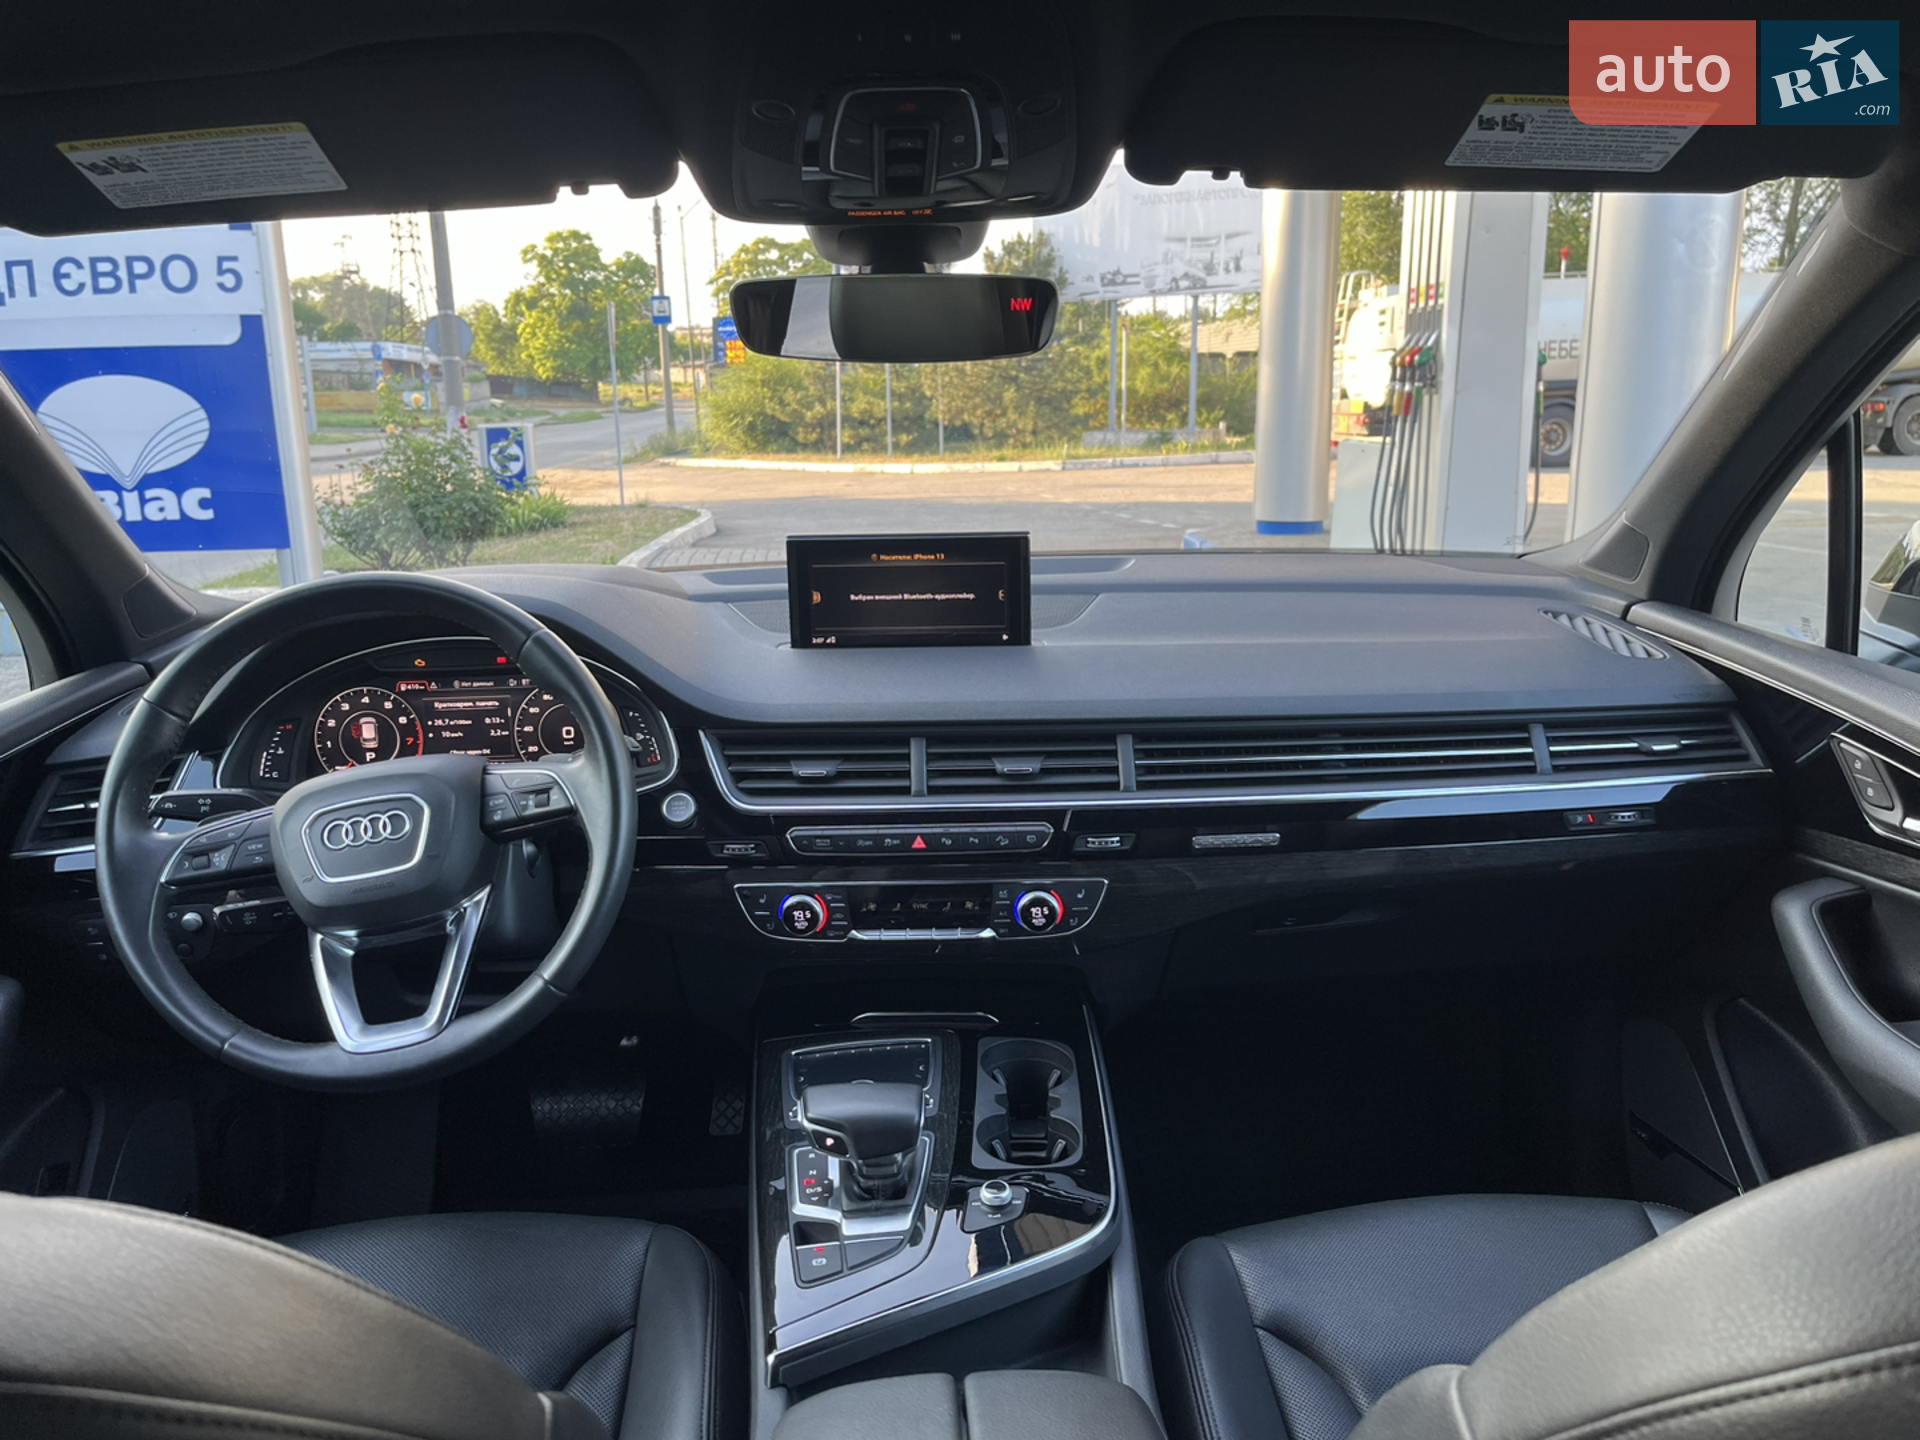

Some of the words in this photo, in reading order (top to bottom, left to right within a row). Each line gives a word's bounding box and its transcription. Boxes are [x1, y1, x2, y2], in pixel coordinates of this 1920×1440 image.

[0, 259, 37, 306] П
[52, 253, 199, 298] ЄВРО
[215, 255, 243, 294] 5
[1010, 297, 1033, 311] NW
[360, 695, 370, 704] 4
[340, 702, 350, 711] 3
[383, 701, 394, 709] 5
[327, 719, 337, 727] 2
[398, 715, 408, 724] 6
[562, 726, 575, 739] 0
[365, 752, 376, 762] P
